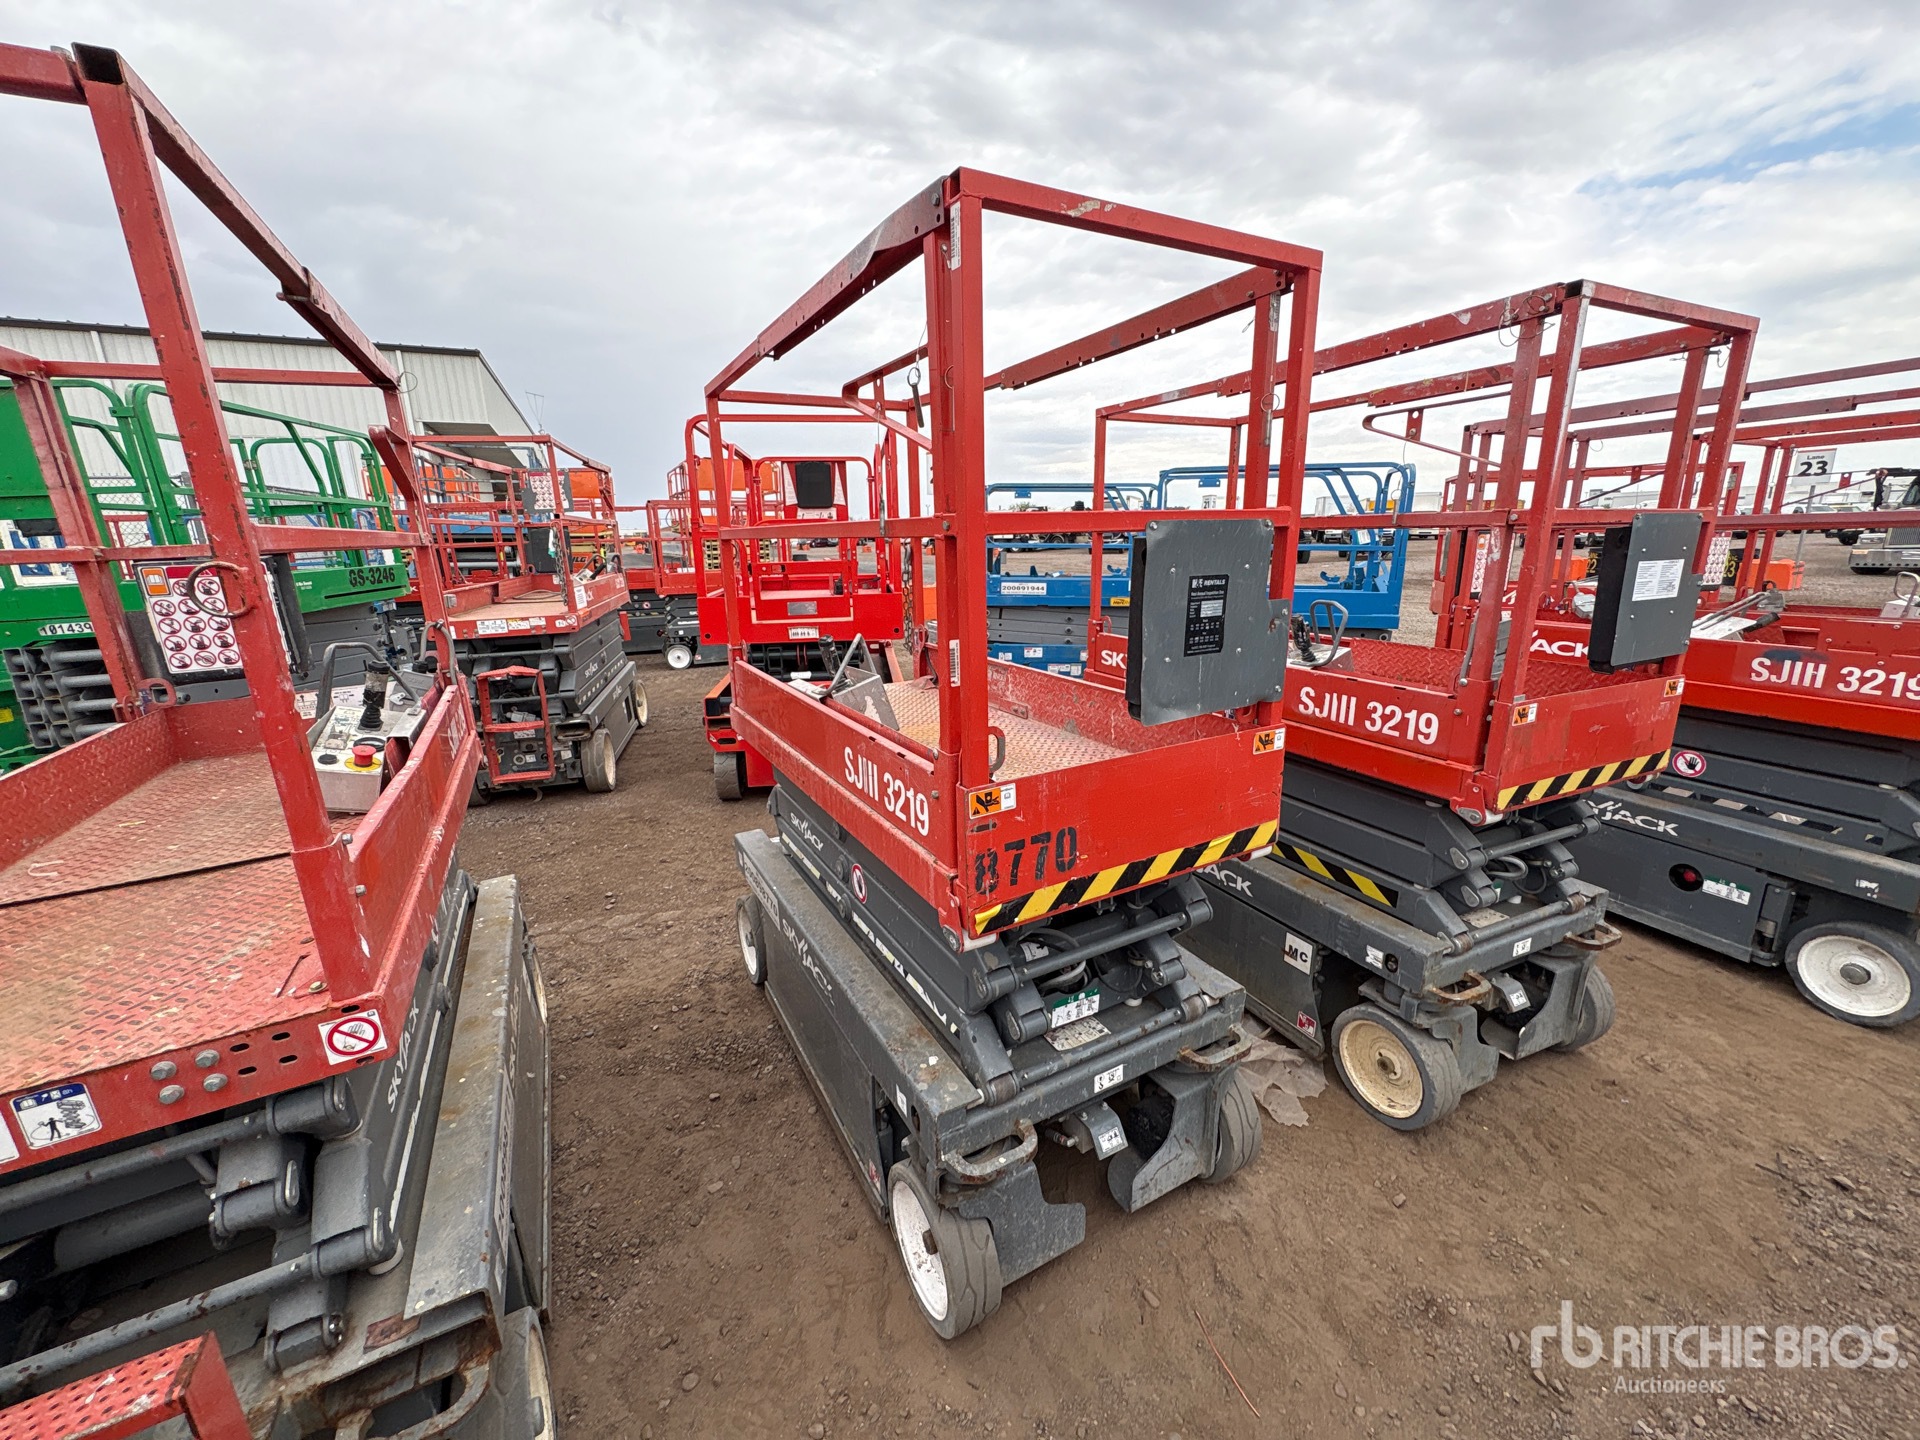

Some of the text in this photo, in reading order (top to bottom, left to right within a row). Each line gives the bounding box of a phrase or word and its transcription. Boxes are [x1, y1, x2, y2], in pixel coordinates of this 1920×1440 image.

[1797, 460, 1829, 477] 23
[349, 567, 395, 588] GS-3246
[1836, 666, 1920, 701] 3219
[1364, 701, 1439, 746] 3219
[883, 772, 930, 838] 3219
[1583, 799, 1679, 837] YJACK
[974, 826, 1078, 896] 8770
[1287, 944, 1309, 963] MC
